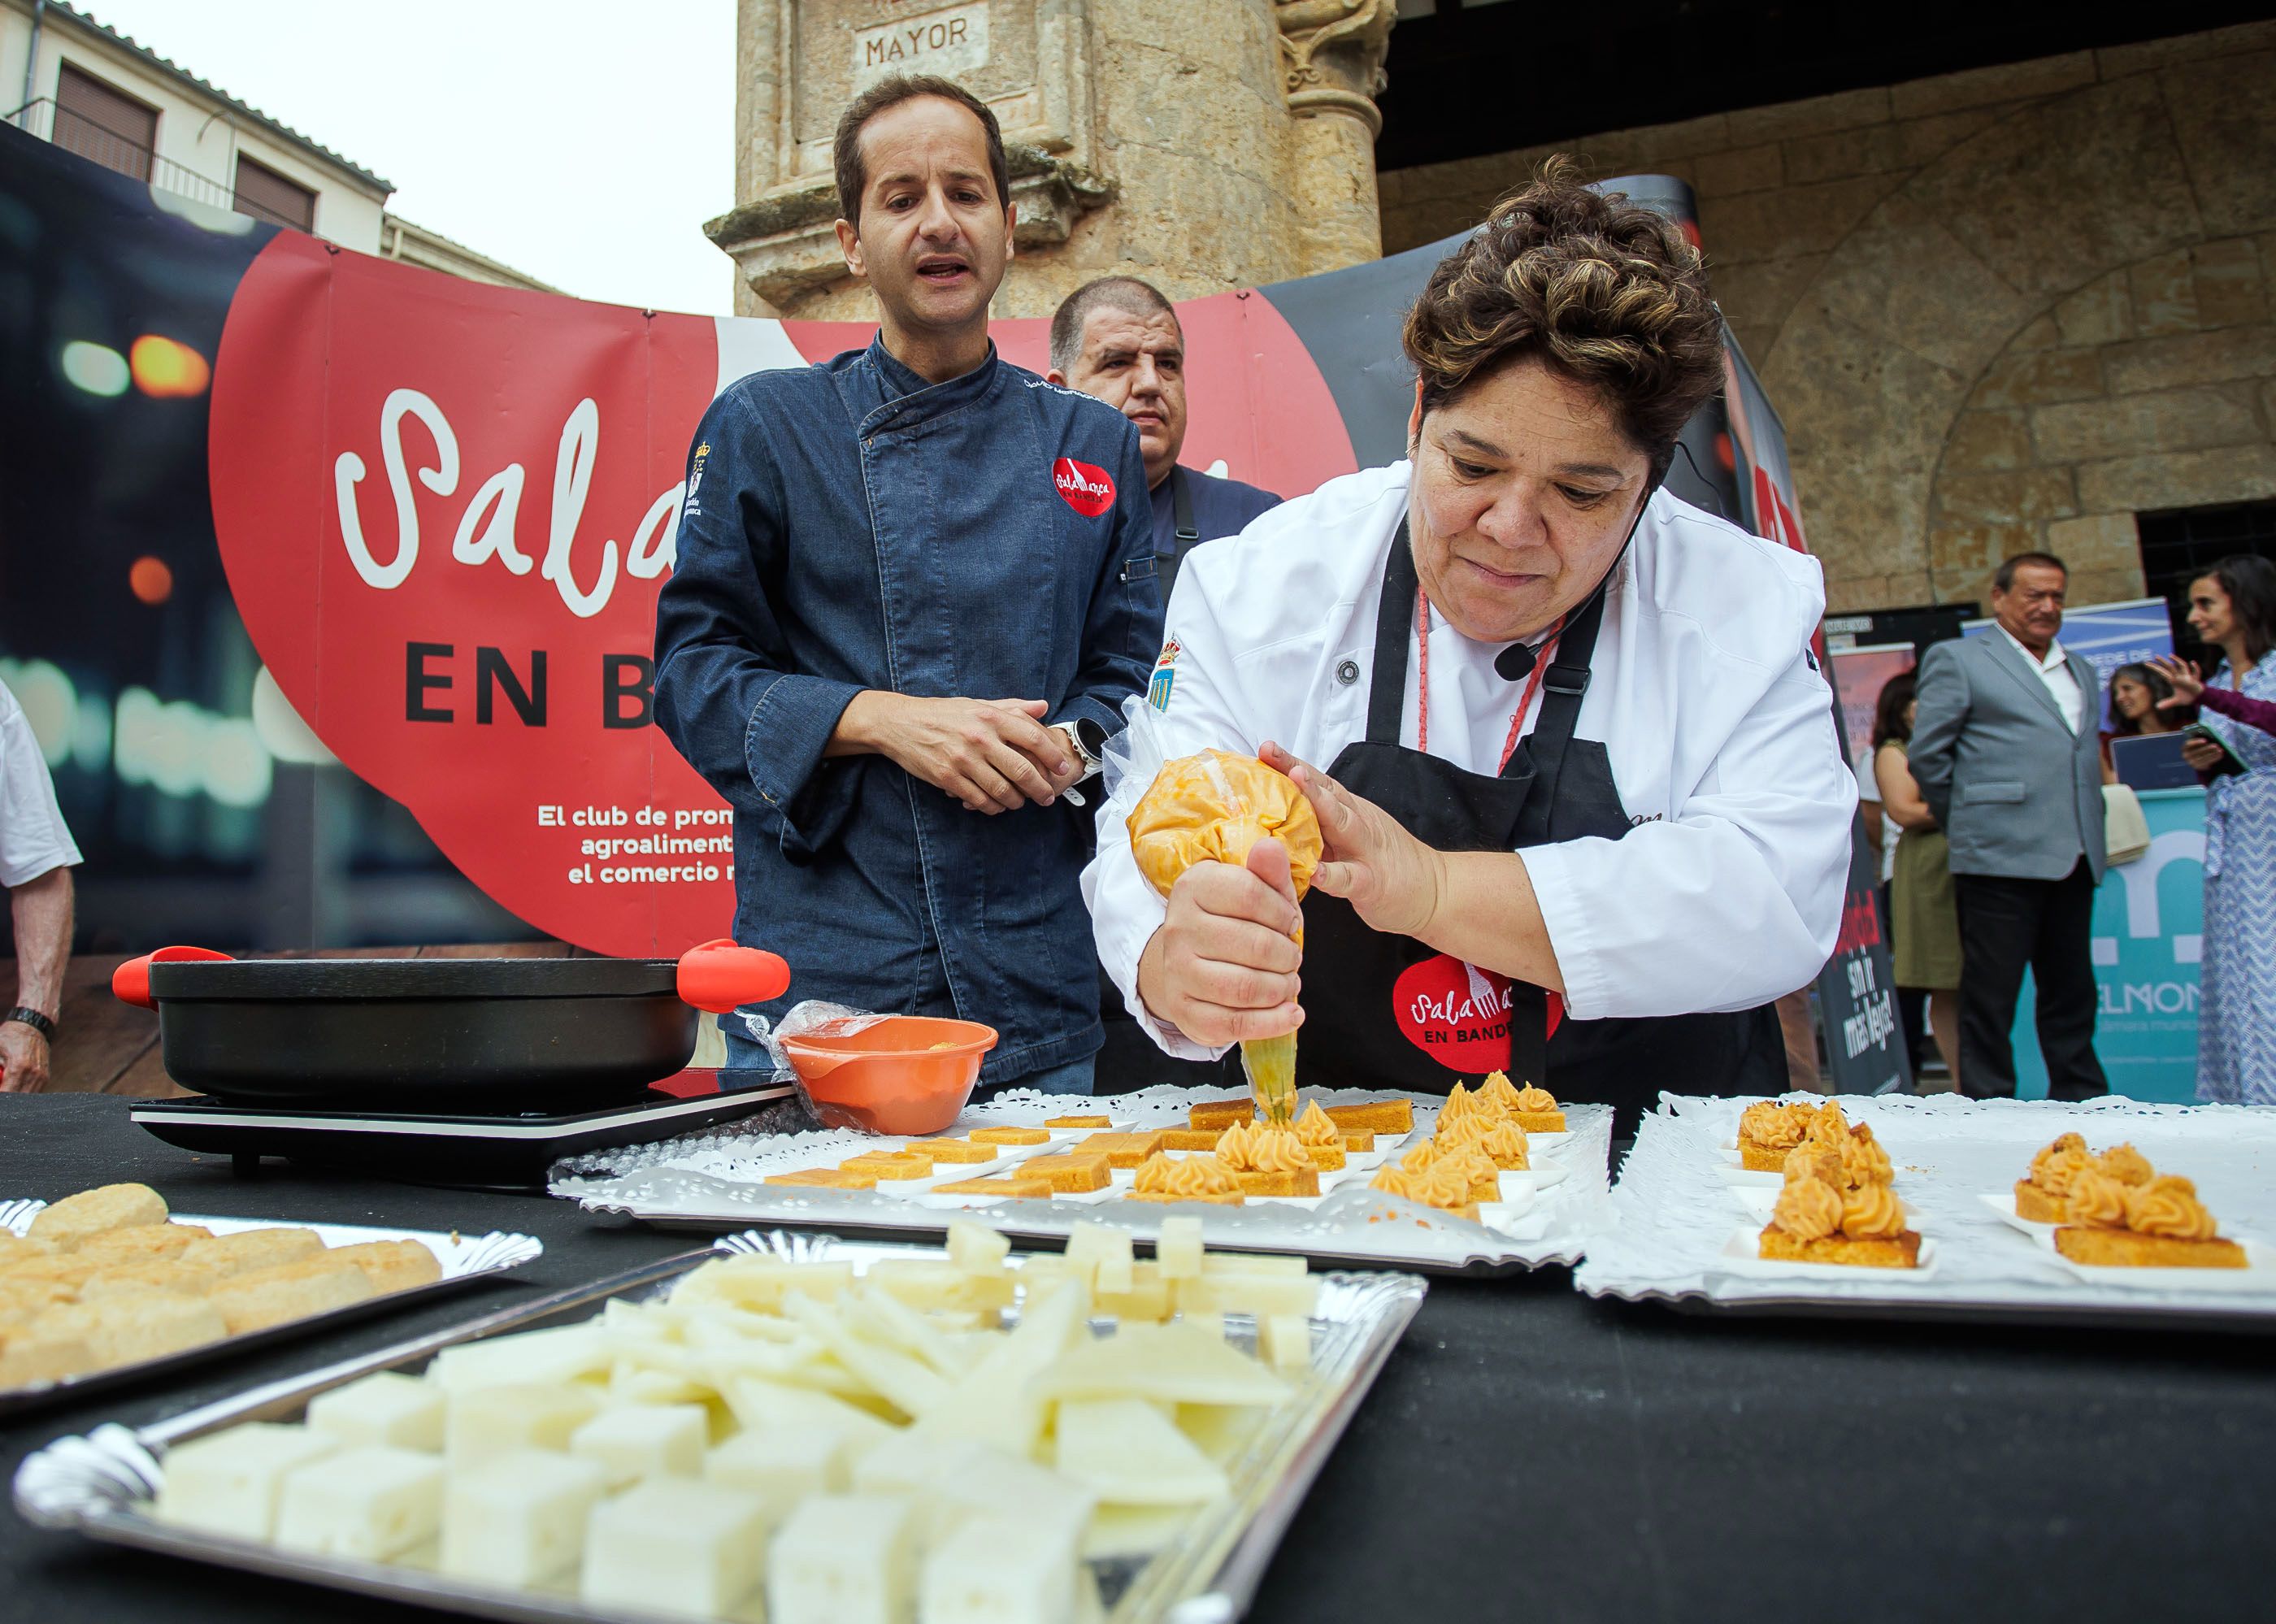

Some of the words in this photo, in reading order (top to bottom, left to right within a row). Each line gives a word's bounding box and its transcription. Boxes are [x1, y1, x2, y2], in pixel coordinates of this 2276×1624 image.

[867, 18, 967, 67] MAYOR
[1023, 379, 1053, 389] DAVID
[406, 640, 547, 728] EN
[537, 805, 567, 827] El
[571, 805, 628, 827] club
[635, 805, 668, 826] de
[568, 862, 594, 884] el
[599, 860, 719, 884] comercio
[1424, 1030, 1448, 1044] EN
